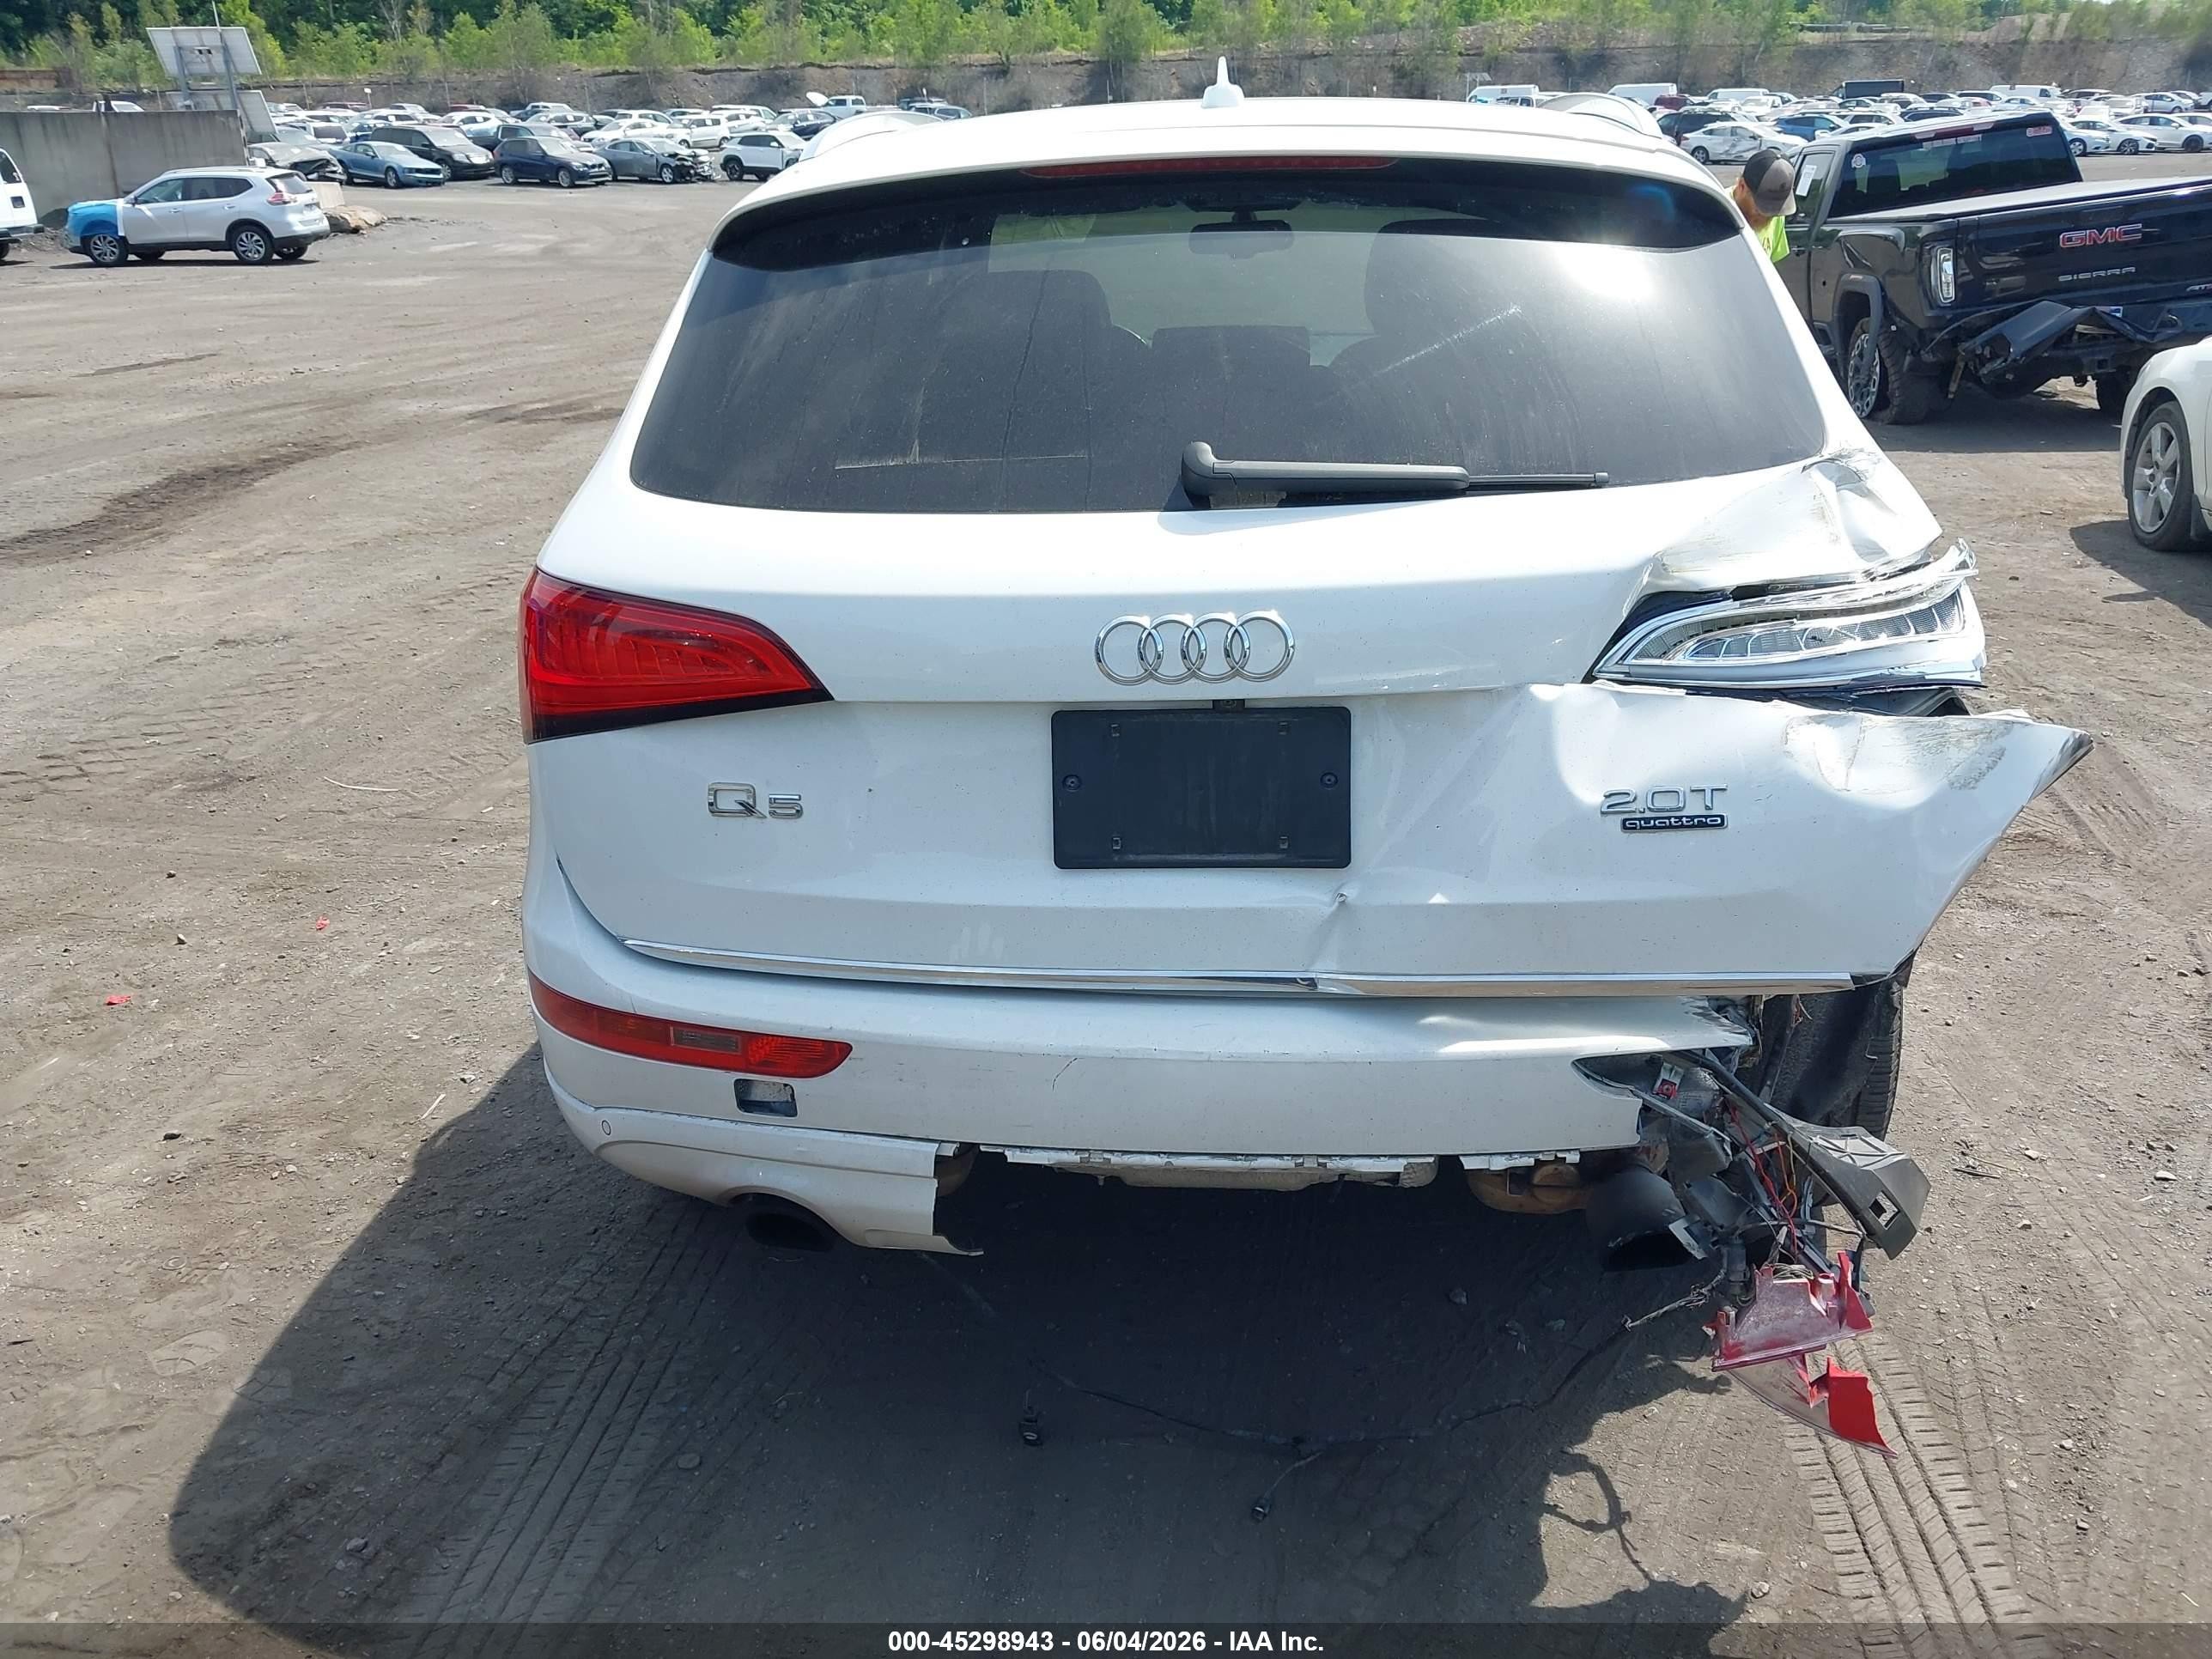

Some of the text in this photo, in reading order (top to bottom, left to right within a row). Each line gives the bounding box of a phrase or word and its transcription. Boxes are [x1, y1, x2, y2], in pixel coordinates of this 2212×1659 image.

[2060, 223, 2142, 248] GMC
[2058, 266, 2136, 282] SIERRA
[708, 781, 804, 818] Q5
[1601, 783, 1729, 814] 2.0T
[1626, 817, 1721, 830] quattro
